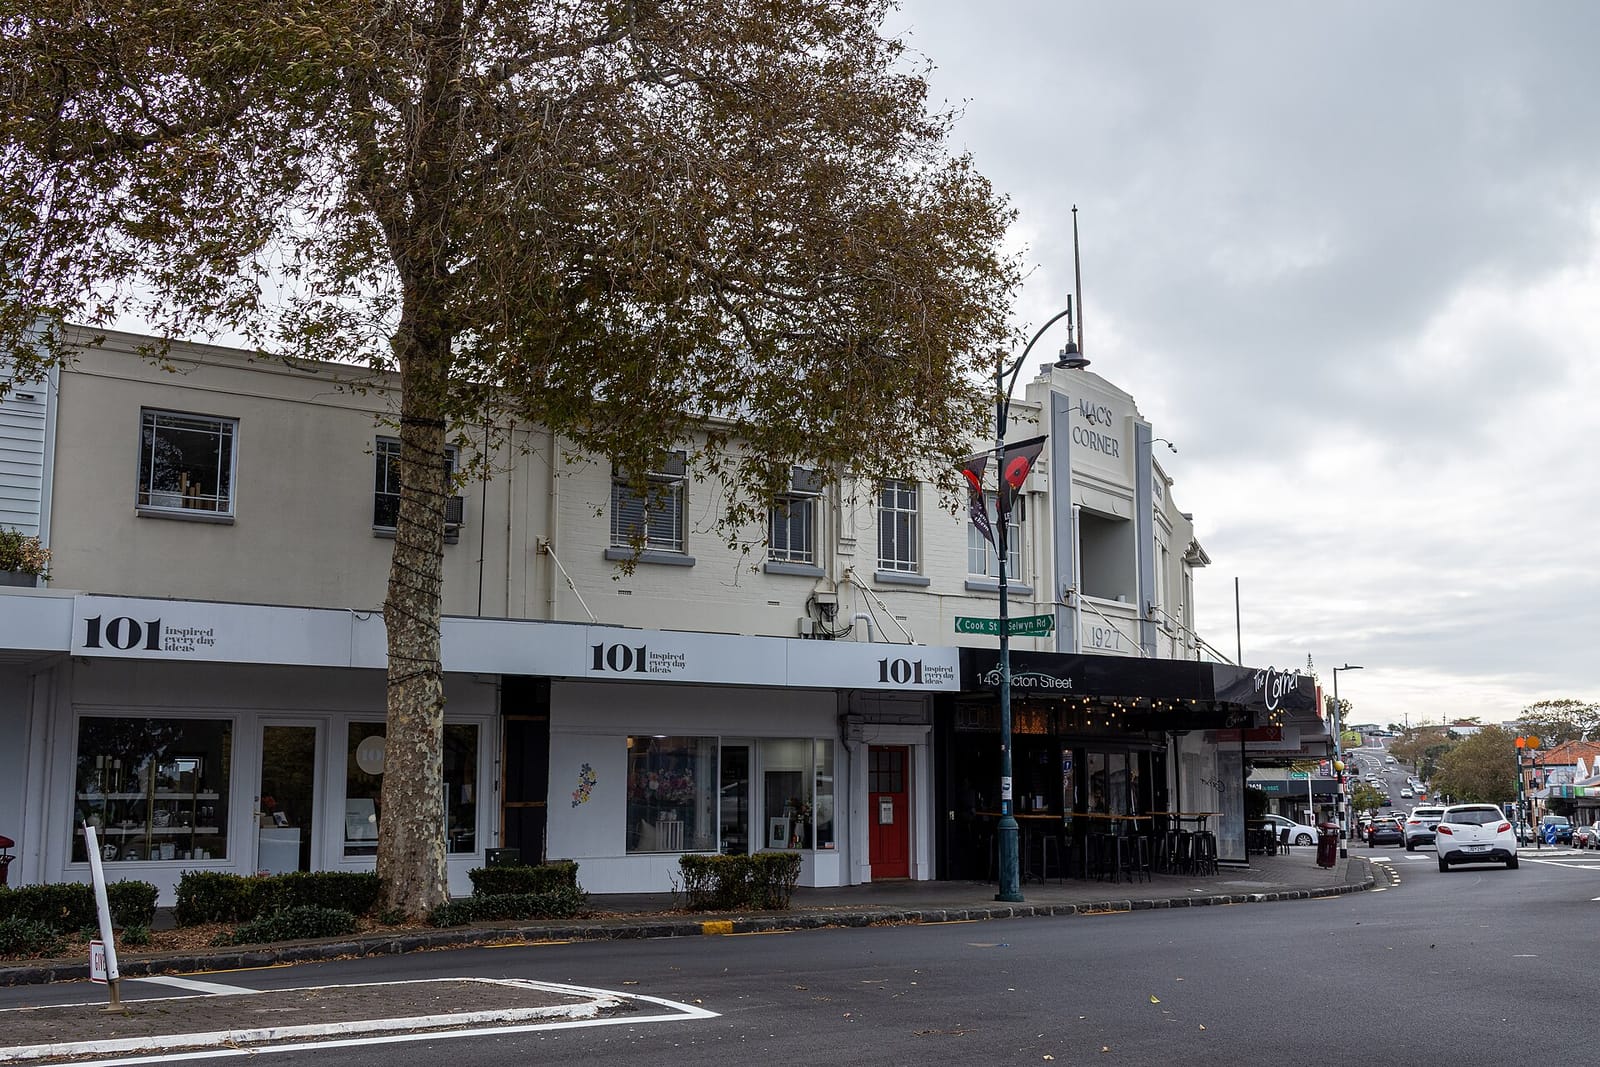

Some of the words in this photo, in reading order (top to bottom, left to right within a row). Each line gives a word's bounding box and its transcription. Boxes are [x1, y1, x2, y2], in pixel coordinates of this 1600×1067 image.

[1080, 398, 1112, 427] MAC'S
[1072, 426, 1120, 458] CORNER
[82, 614, 162, 651] 101
[165, 626, 213, 638] inspired
[965, 620, 984, 631] Cook
[988, 622, 998, 631] St
[1008, 621, 1034, 632] Selwyn
[1036, 618, 1046, 628] Rd
[164, 643, 195, 652] ideas
[1092, 626, 1120, 649] 1927
[590, 642, 648, 672] 101
[649, 651, 685, 661] inspired
[877, 657, 924, 684] 101
[976, 673, 1000, 686] 143
[1010, 673, 1038, 687] icton
[1040, 677, 1073, 689] Street
[1264, 666, 1301, 710] Corner
